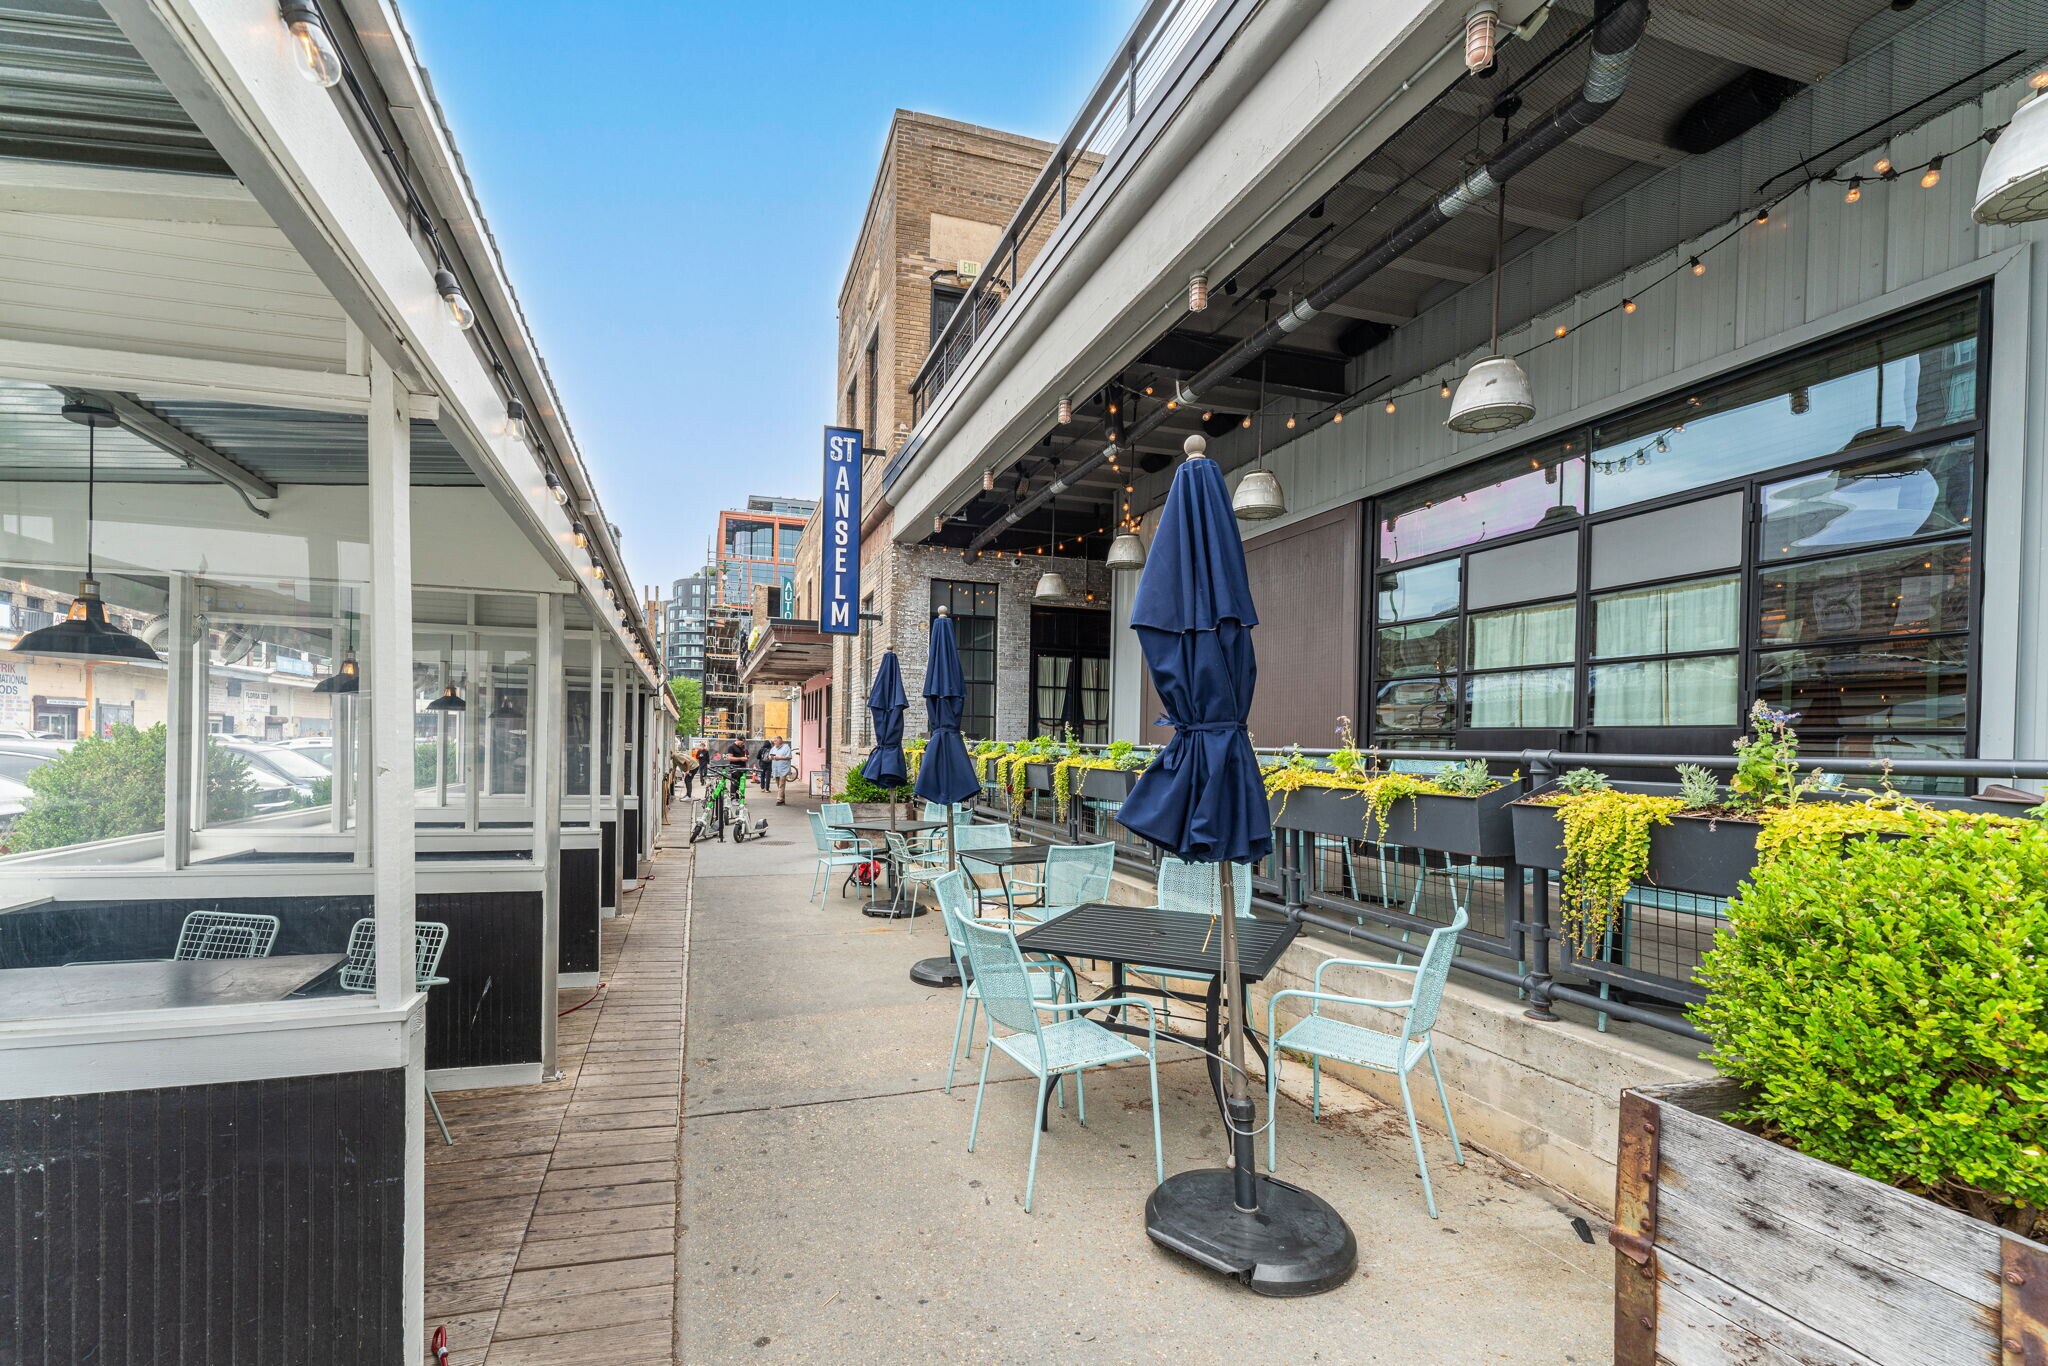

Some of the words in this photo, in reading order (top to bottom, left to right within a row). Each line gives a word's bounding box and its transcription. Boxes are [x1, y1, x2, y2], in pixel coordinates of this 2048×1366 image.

[963, 261, 977, 275] EXIT
[830, 436, 856, 462] ST
[831, 466, 849, 627] ANSELM
[784, 581, 792, 619] AUTO
